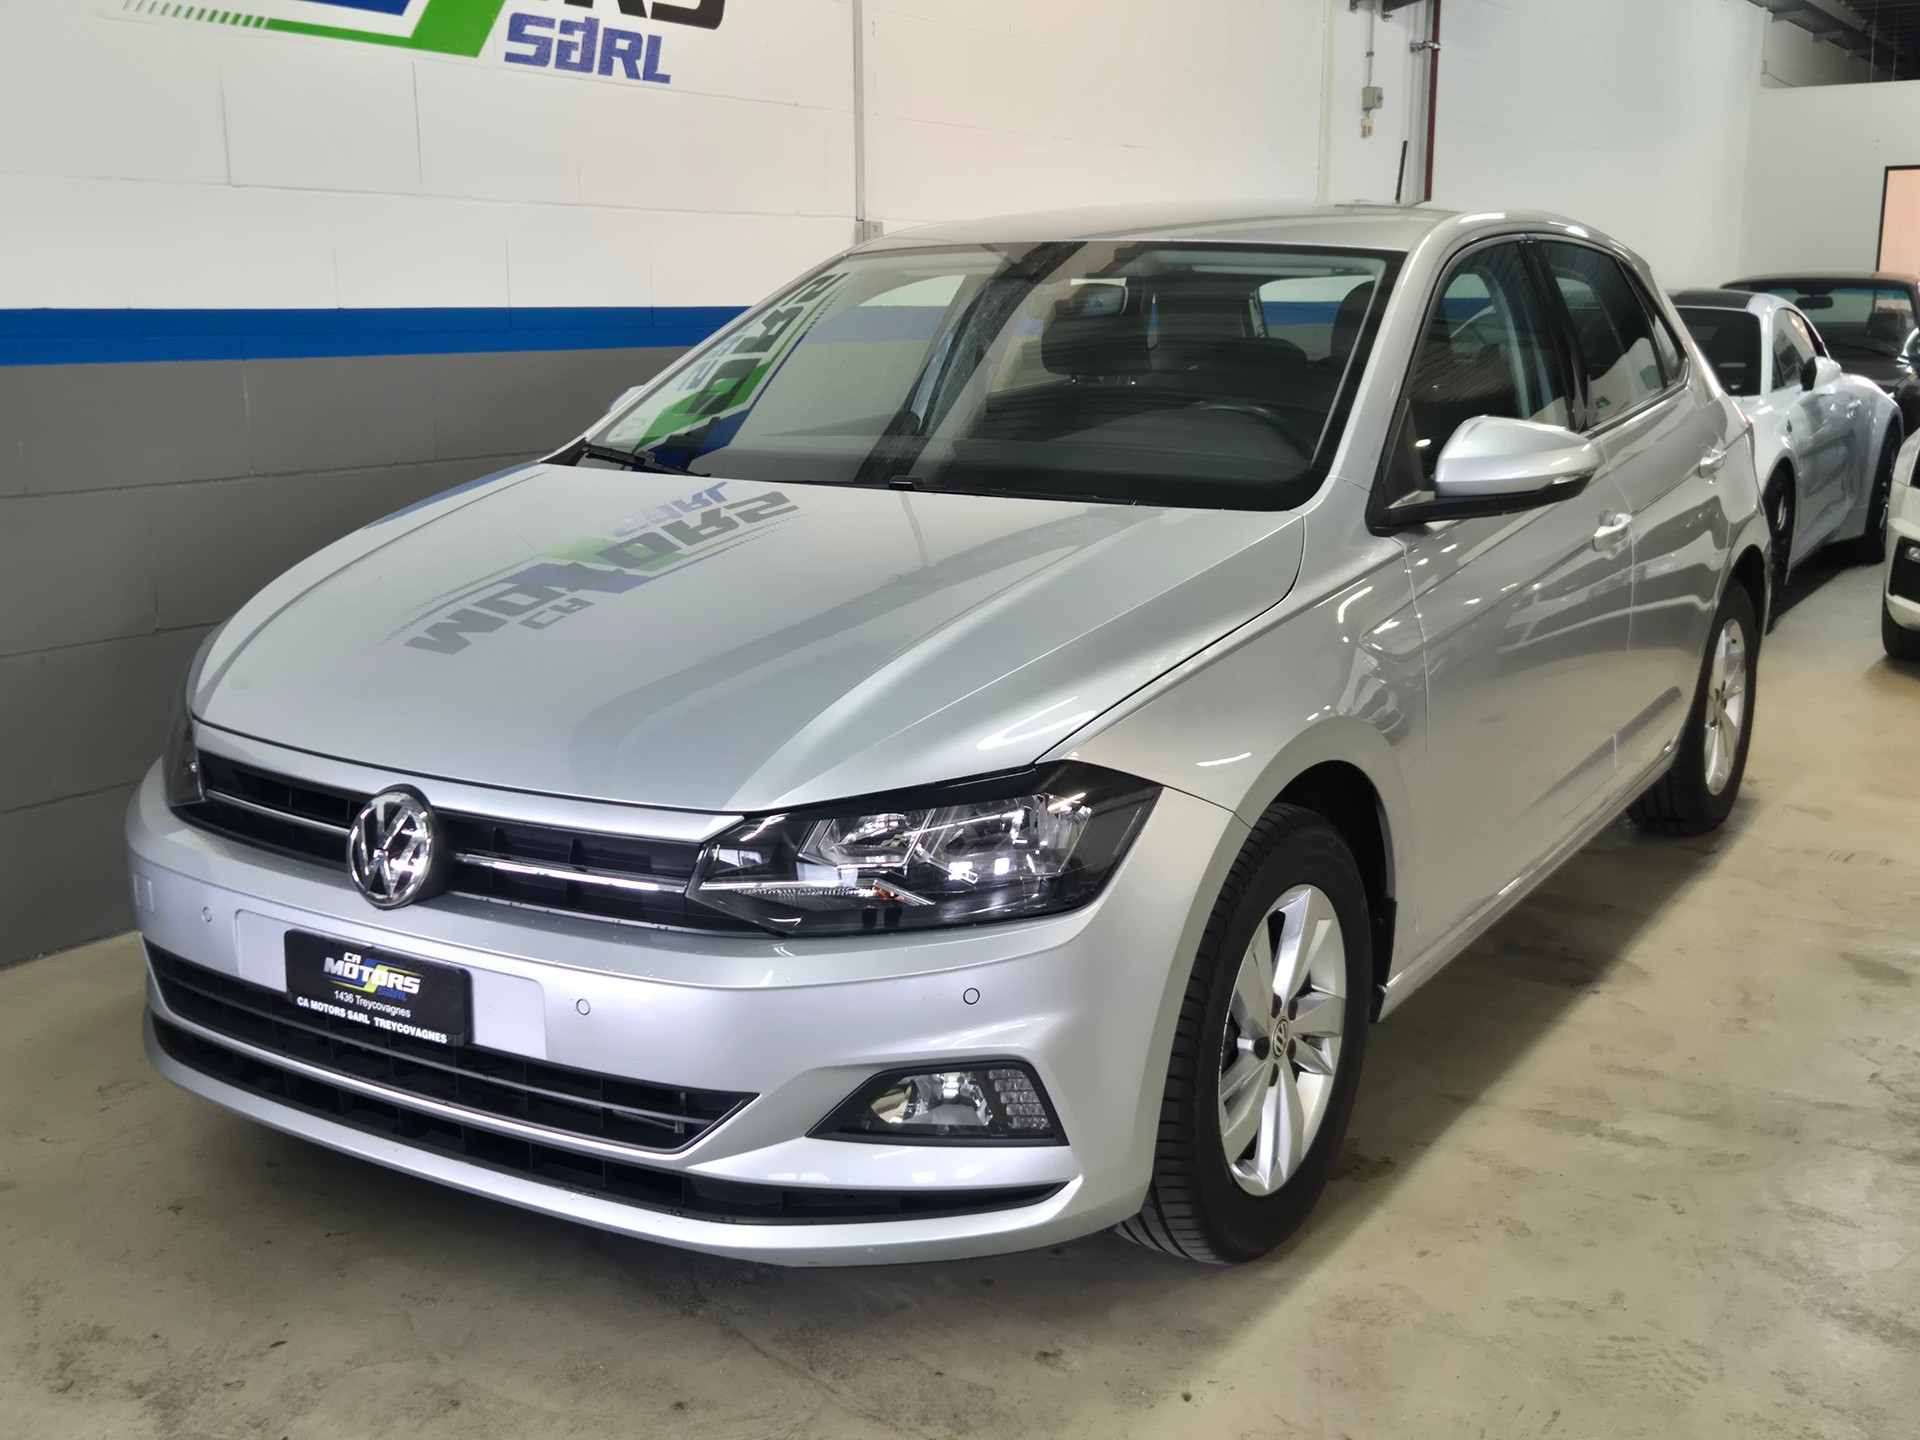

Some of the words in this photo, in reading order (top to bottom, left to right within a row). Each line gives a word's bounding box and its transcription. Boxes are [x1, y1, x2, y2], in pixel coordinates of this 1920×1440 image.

[343, 952, 361, 964] CA
[323, 957, 421, 994] MOTORS
[297, 996, 309, 1009] CA
[311, 1000, 346, 1018] MOTORS
[347, 1010, 370, 1024] SARL
[374, 1017, 447, 1044] TREYCOVAGNES
[334, 990, 354, 1003] 1436
[355, 995, 411, 1018] Treycovagnes
